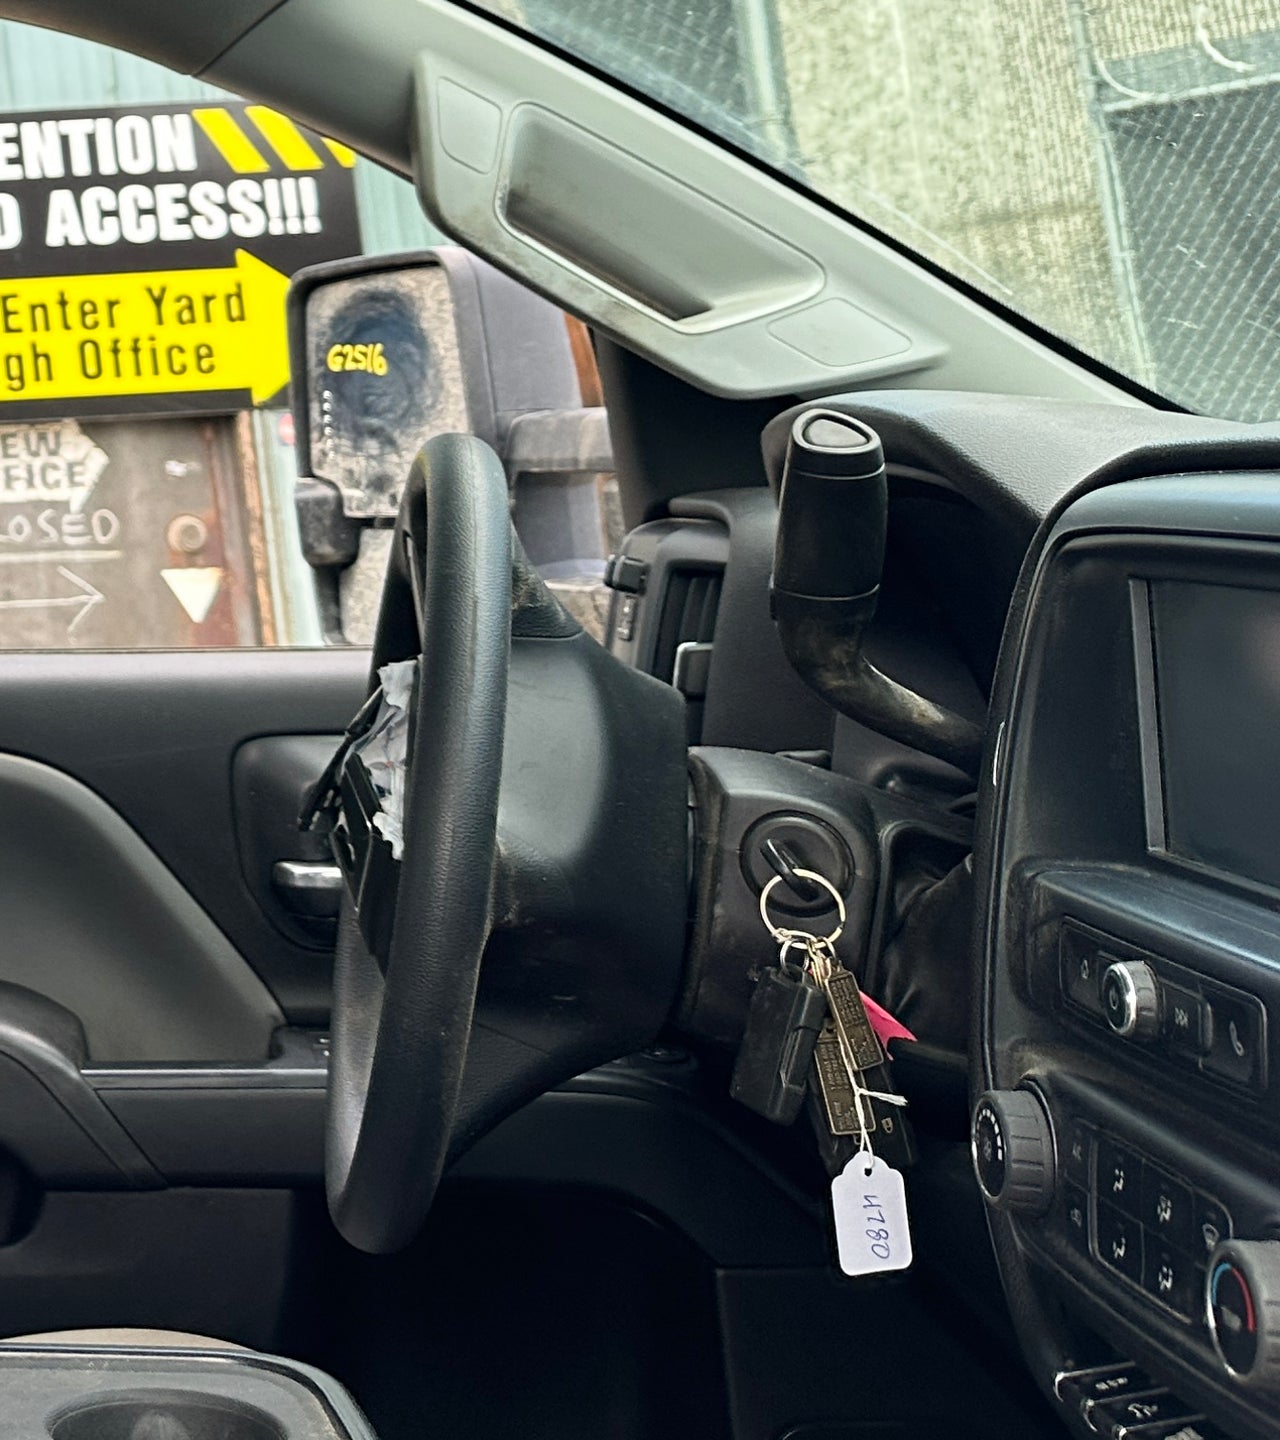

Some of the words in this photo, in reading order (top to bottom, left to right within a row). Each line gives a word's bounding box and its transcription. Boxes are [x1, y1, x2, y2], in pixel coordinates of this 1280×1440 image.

[45, 176, 322, 249] ACCESS!!!
[0, 291, 122, 335] Enter
[145, 283, 247, 328] Yard
[80, 337, 217, 382] Office
[327, 342, 388, 376] G2516
